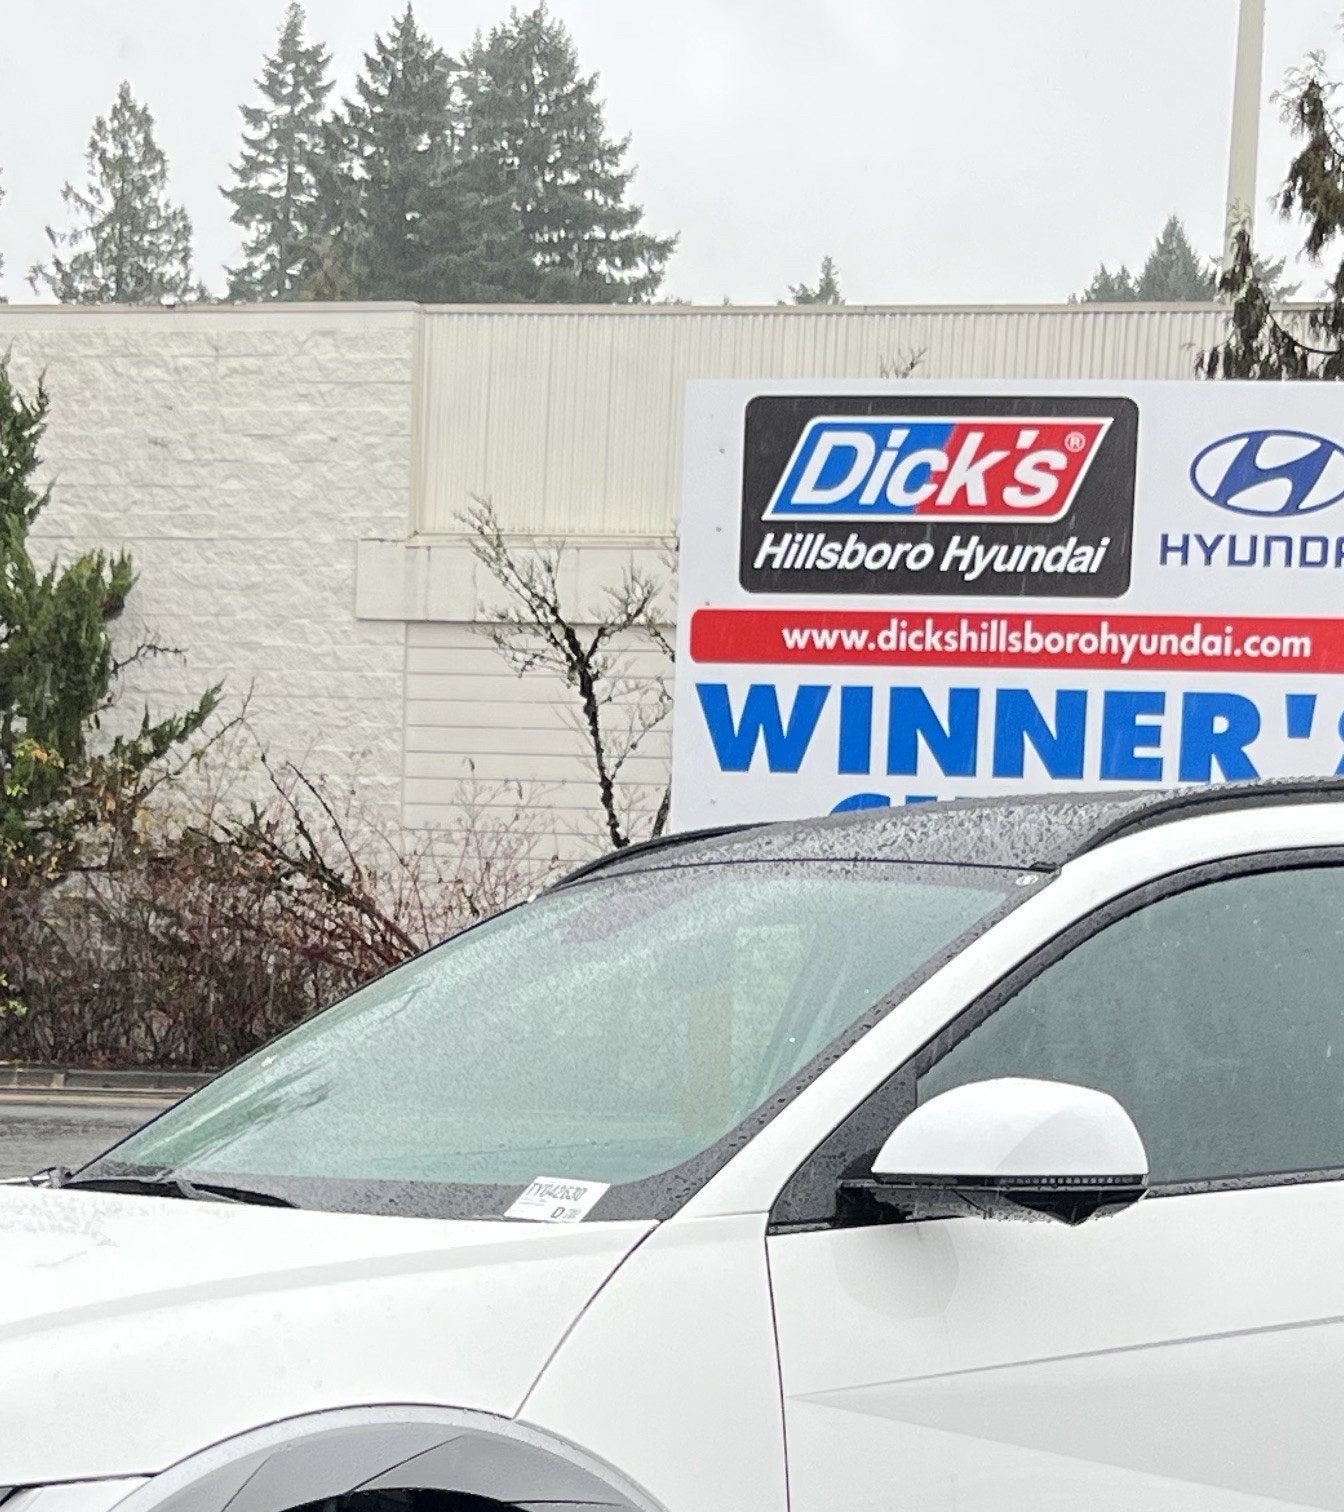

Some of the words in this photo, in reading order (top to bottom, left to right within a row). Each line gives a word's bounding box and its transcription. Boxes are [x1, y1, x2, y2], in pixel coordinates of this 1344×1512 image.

[791, 428, 1068, 509] Dick's
[753, 532, 934, 570] Hillsboro
[940, 534, 1111, 582] Hyundai
[782, 618, 1312, 663] www.dickshillsborohyundai.com
